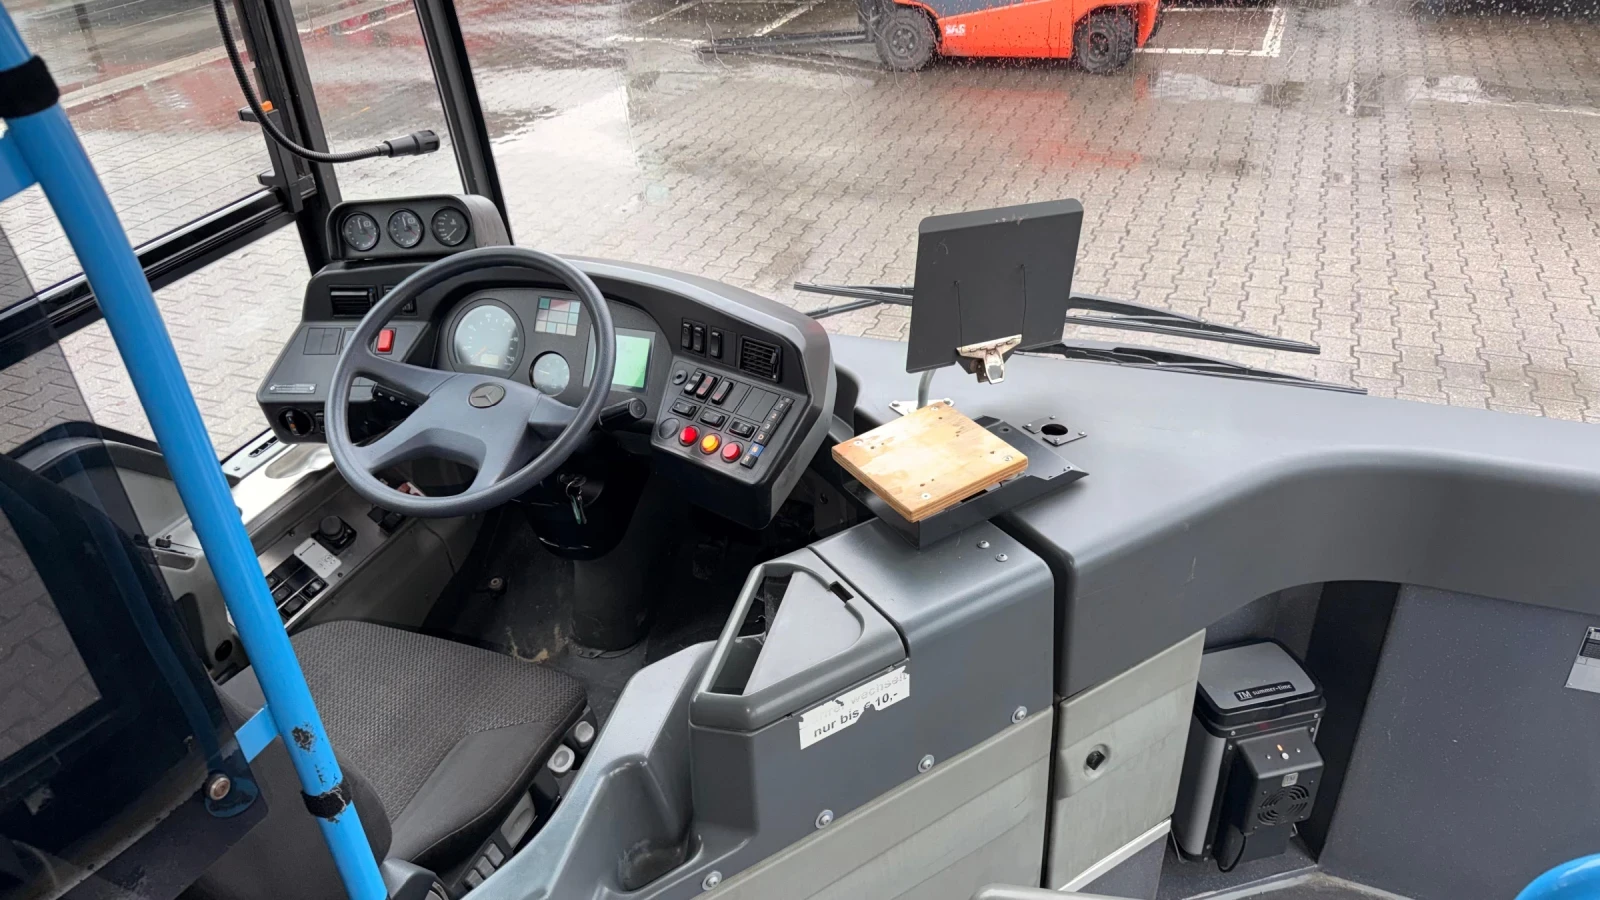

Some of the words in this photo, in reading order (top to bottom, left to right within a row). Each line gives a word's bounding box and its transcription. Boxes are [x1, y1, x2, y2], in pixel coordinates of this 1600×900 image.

[1252, 684, 1292, 696] summer-time
[814, 720, 837, 738] nur
[840, 709, 860, 725] bis
[875, 692, 898, 707] 10,-
